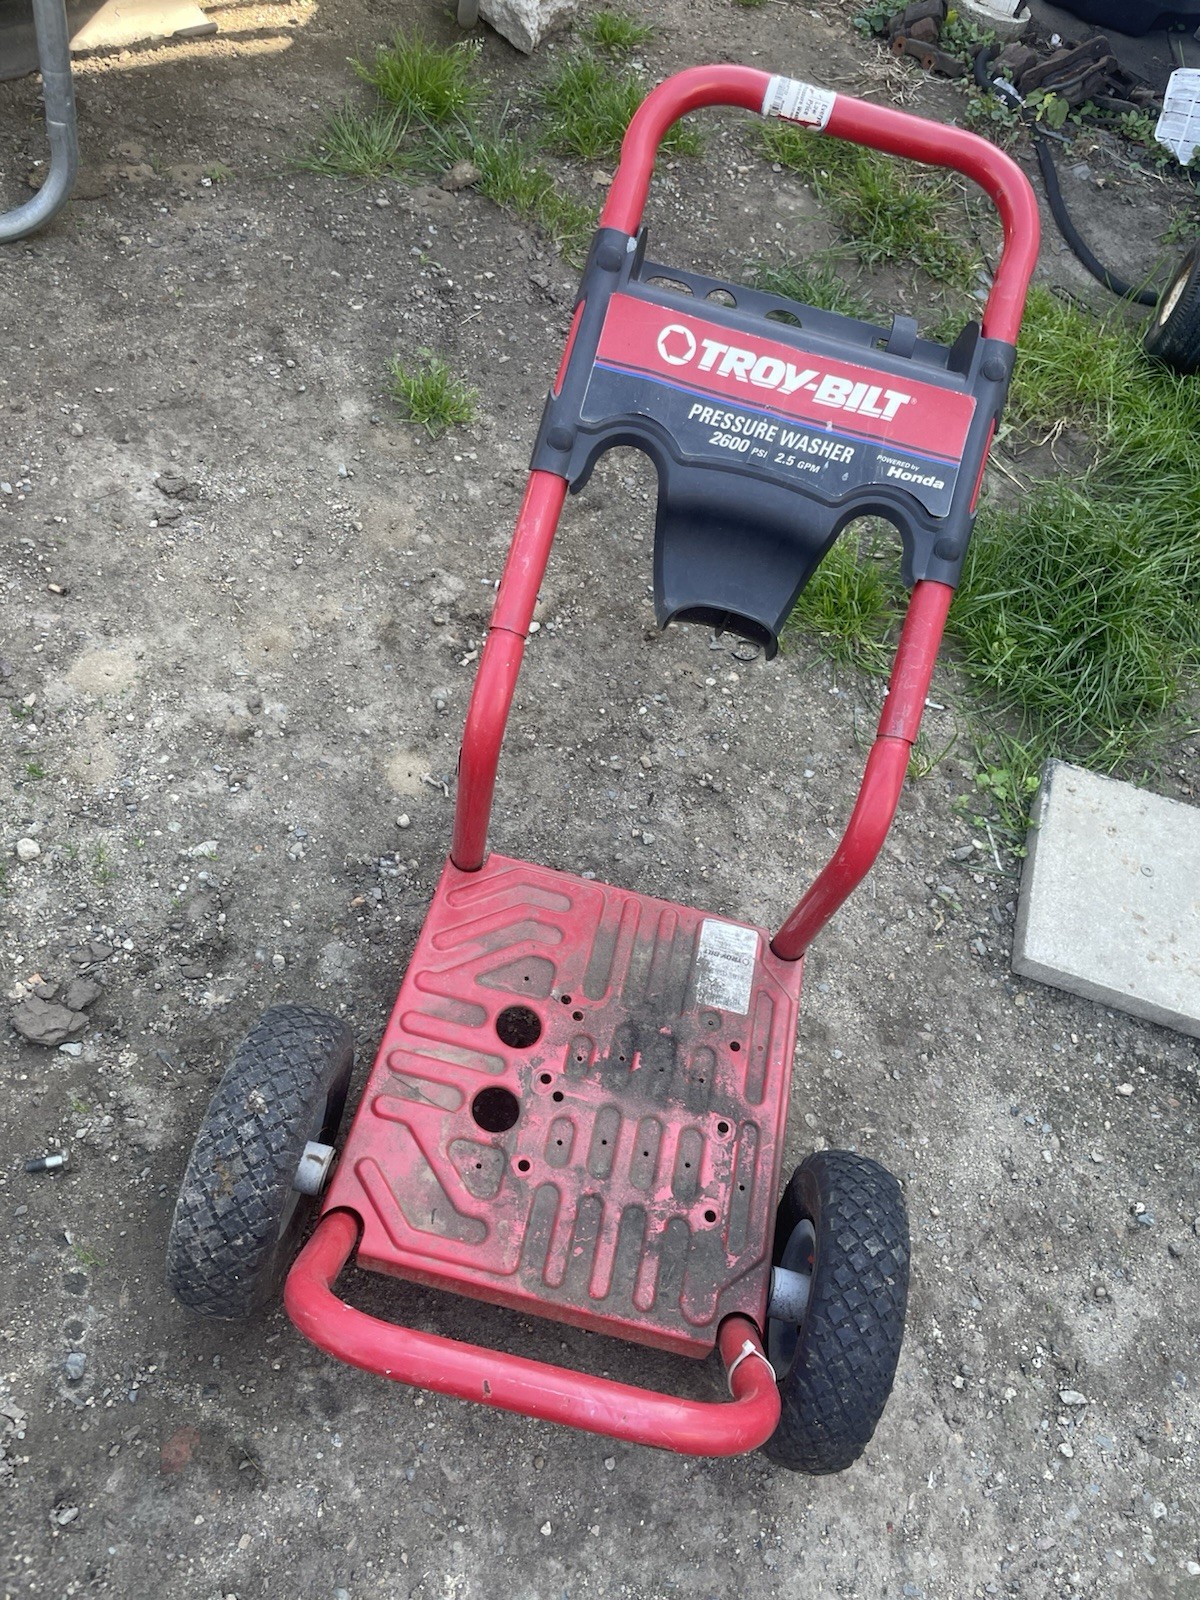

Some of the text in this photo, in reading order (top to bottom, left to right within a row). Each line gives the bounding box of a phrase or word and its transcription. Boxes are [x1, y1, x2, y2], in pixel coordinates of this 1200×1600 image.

[698, 338, 911, 422] TROY-BILT
[688, 403, 855, 464] PRESSURE WASHER
[709, 431, 821, 474] 2600 PSI 2.5 GPM
[877, 454, 920, 471] POWERED by
[887, 465, 945, 490] Honda
